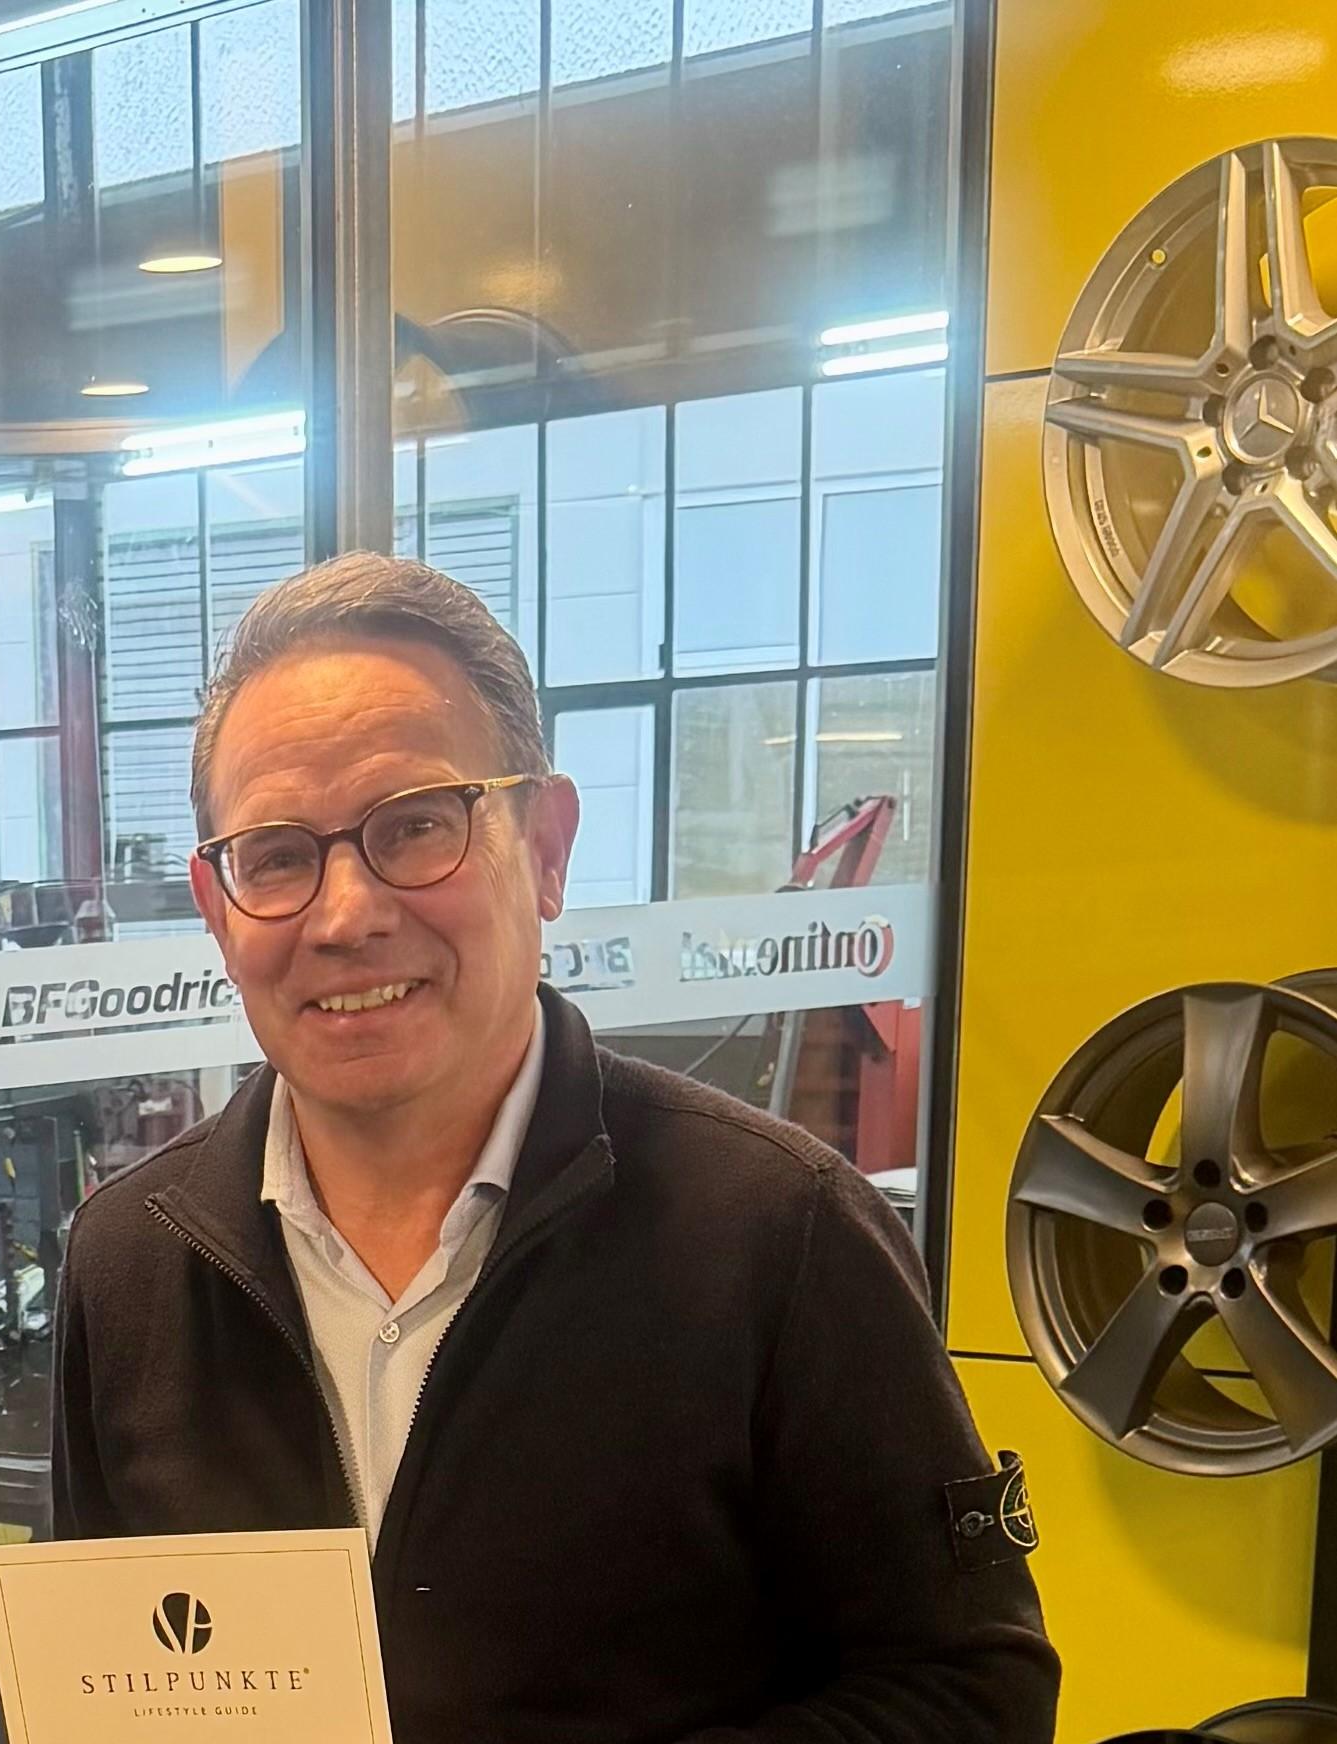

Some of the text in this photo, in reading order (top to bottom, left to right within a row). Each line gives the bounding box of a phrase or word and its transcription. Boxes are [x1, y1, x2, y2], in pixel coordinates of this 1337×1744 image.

[2, 969, 241, 1027] BFGoodric
[134, 1705, 258, 1717] LIFESTYLE GUIDE
